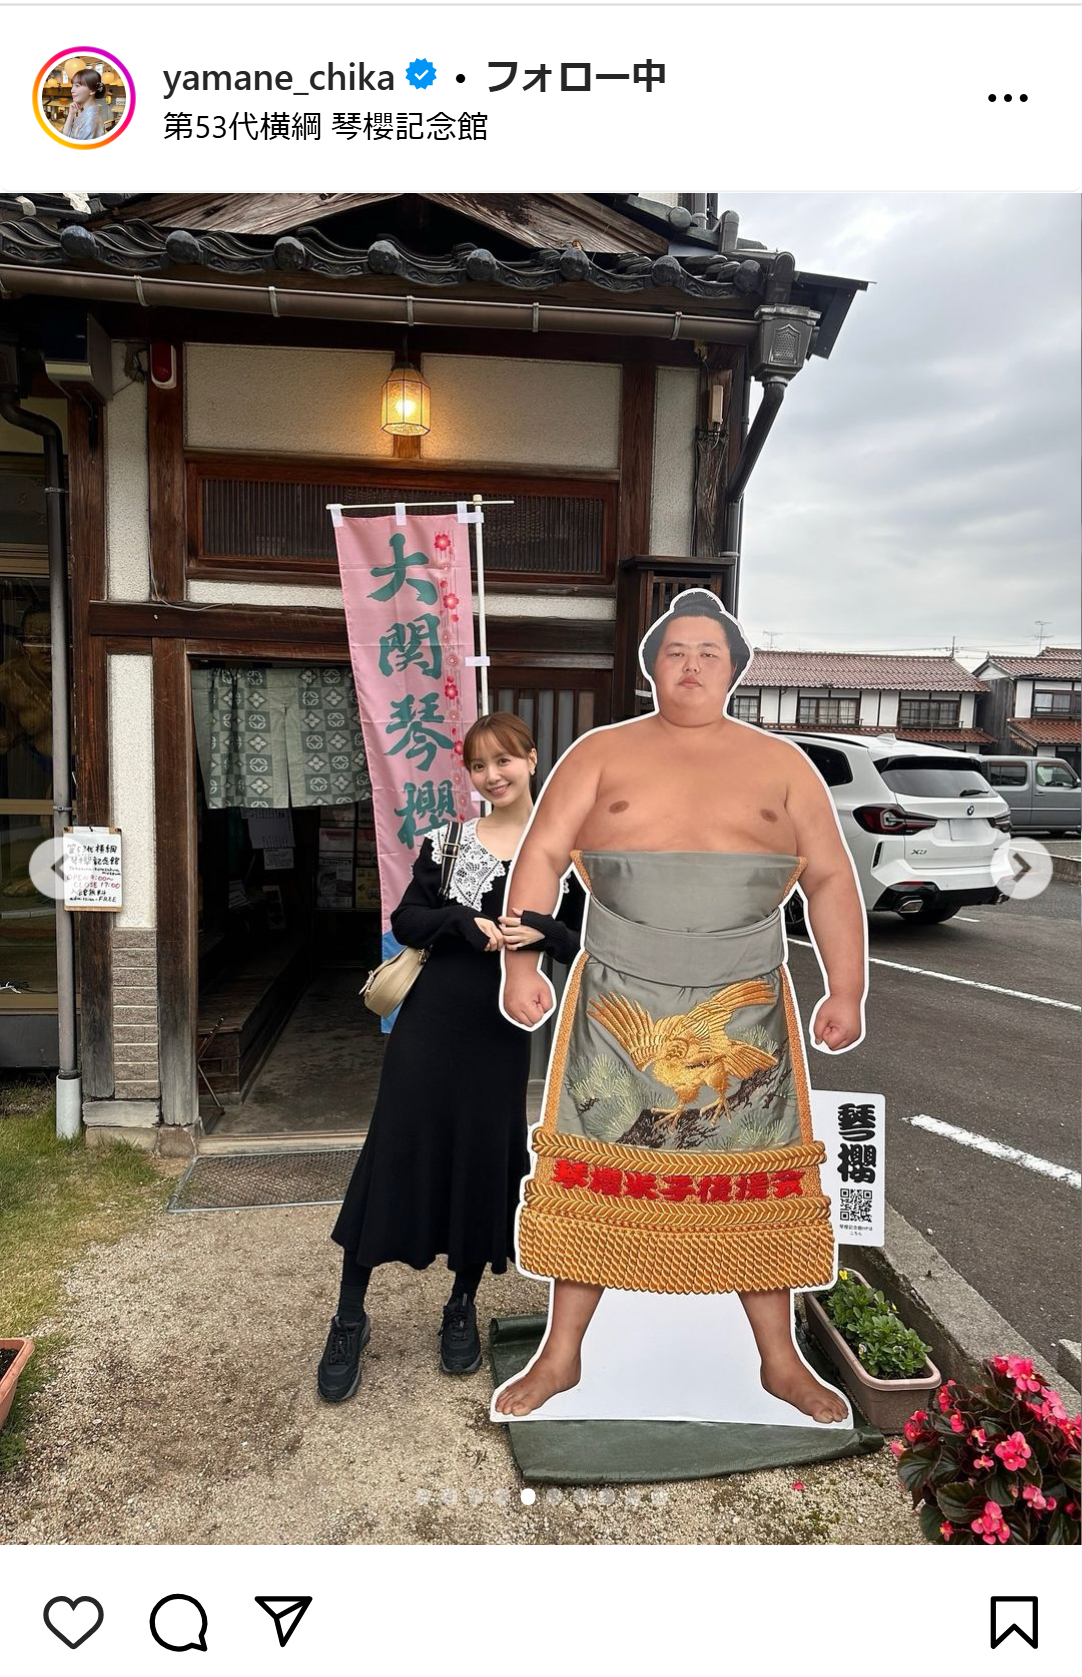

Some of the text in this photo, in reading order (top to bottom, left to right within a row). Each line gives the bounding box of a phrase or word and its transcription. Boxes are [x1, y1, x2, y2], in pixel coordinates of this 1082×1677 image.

[366, 532, 456, 851] 大関琴櫻
[836, 1102, 877, 1184] 琴櫻
